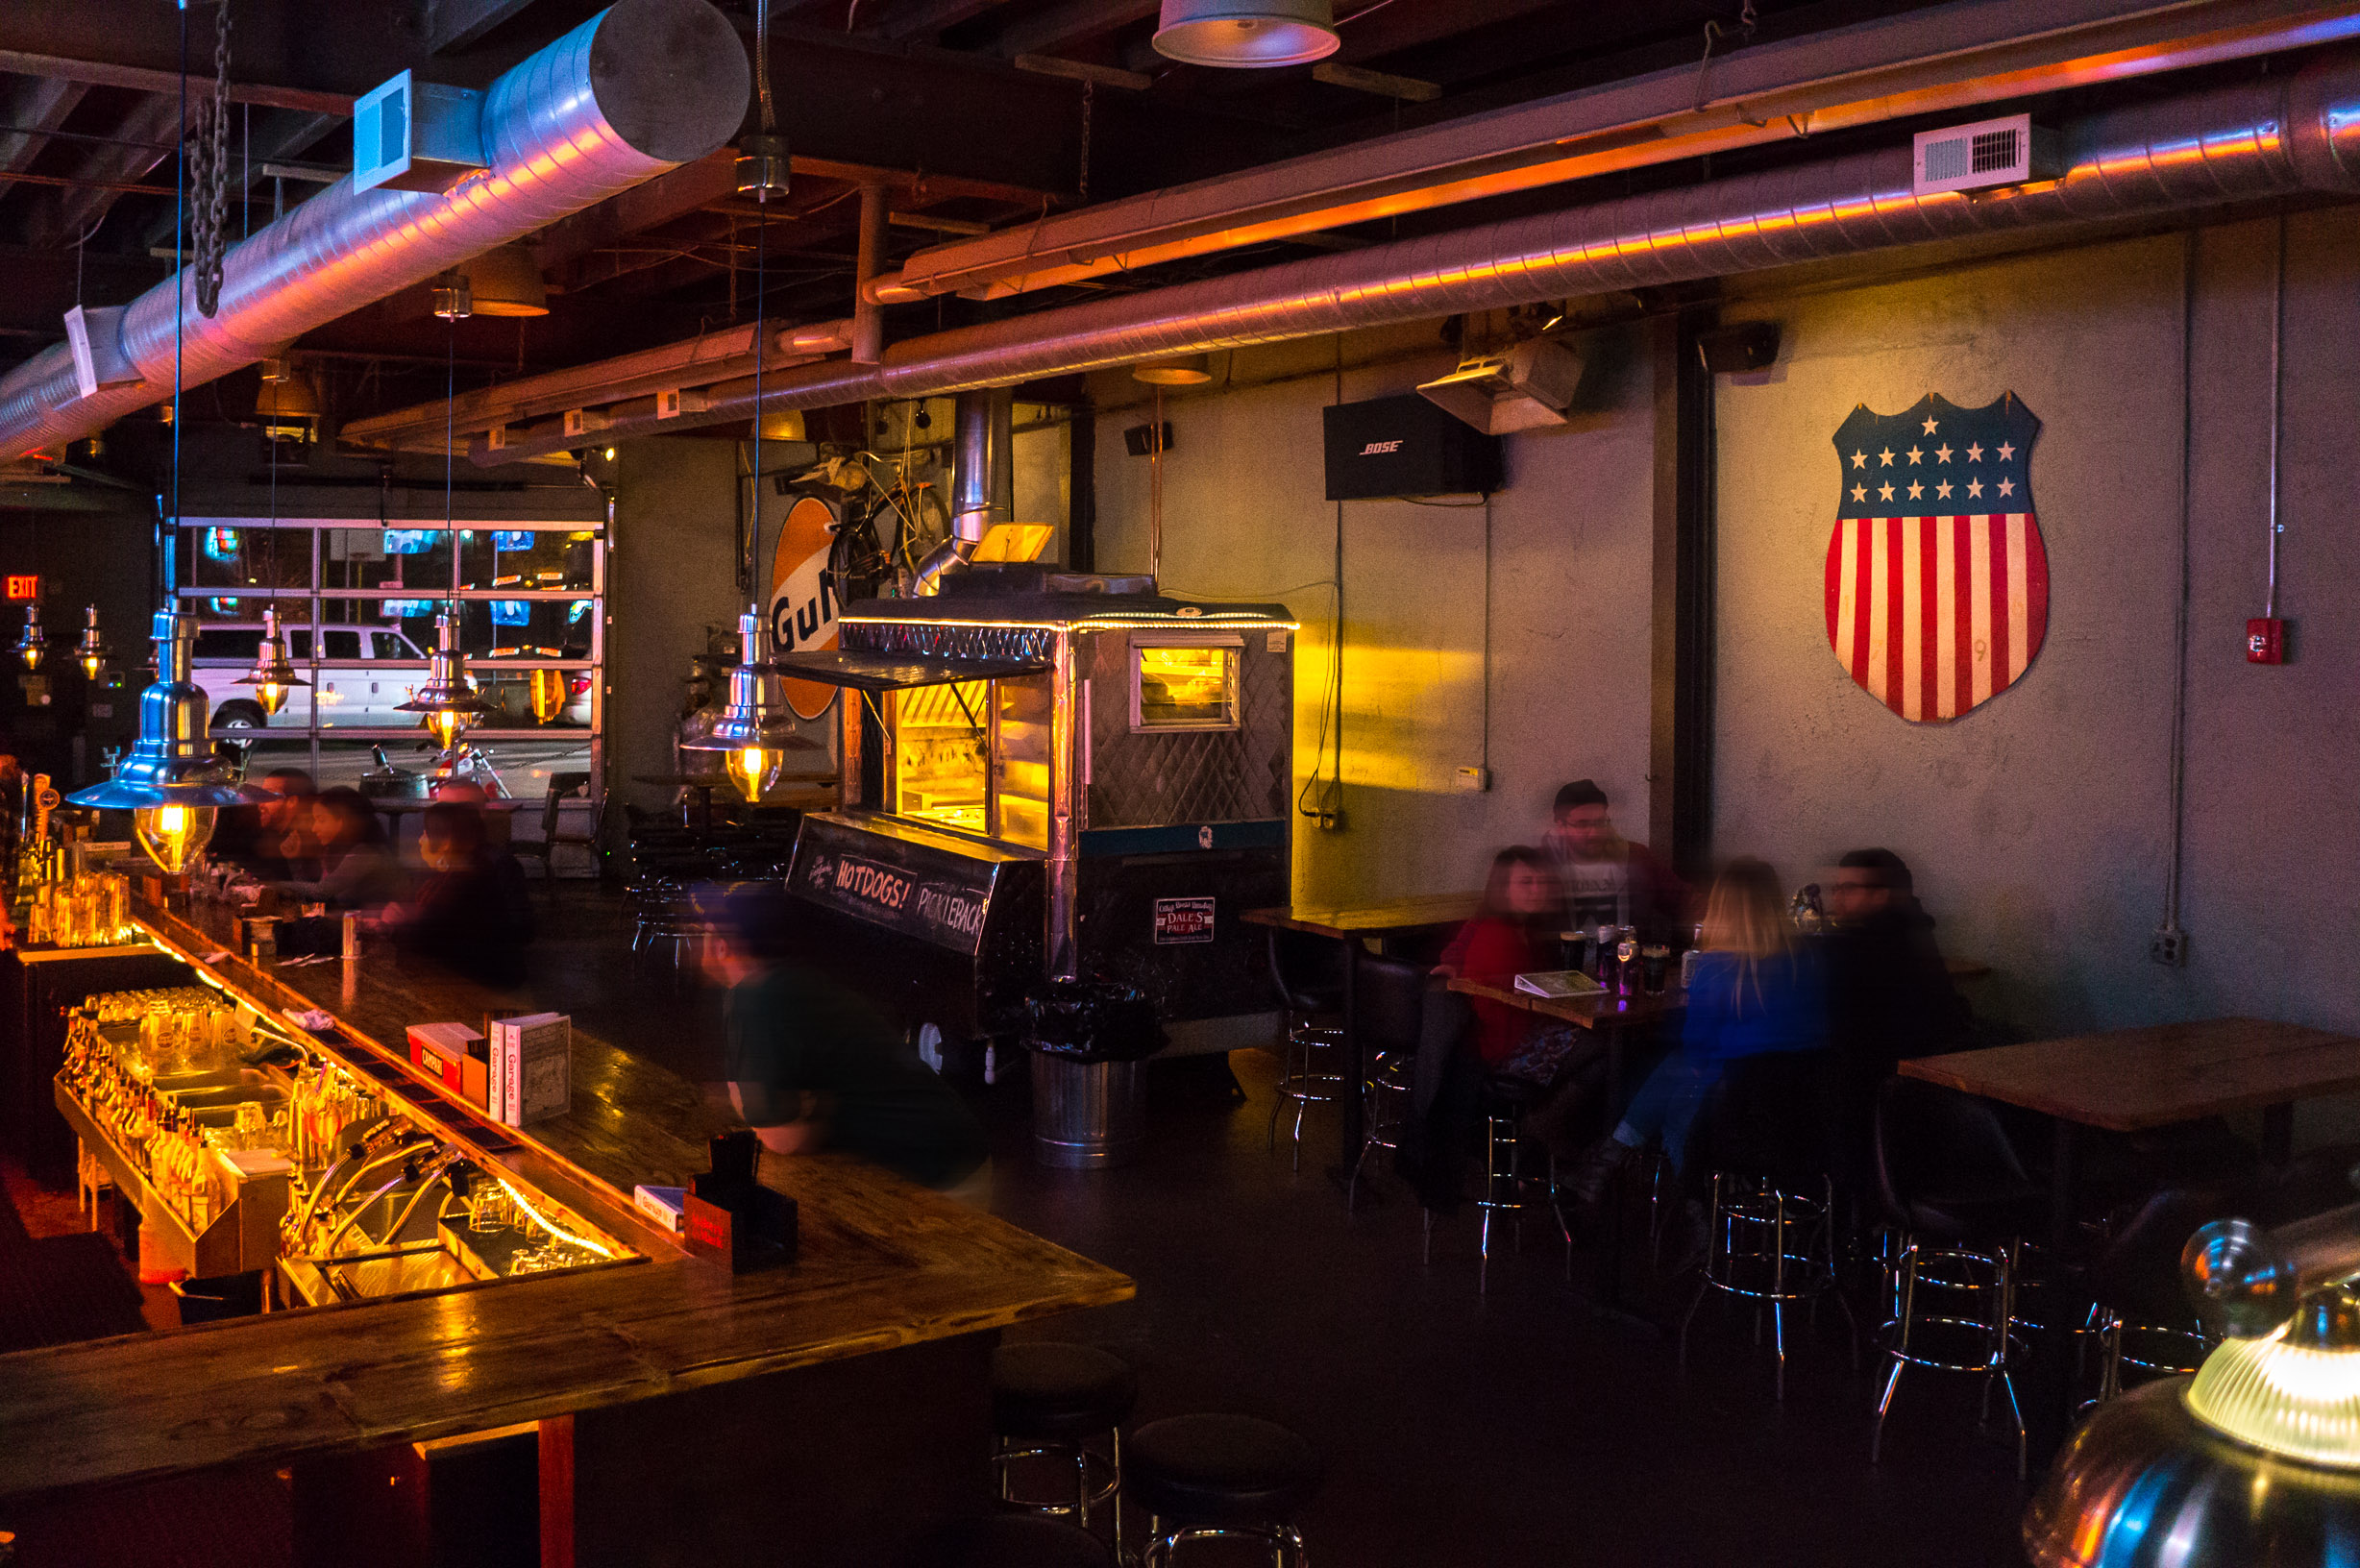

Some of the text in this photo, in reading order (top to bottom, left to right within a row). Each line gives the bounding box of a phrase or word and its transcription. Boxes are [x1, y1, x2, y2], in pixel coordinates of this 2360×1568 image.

[1359, 439, 1404, 456] BOSE
[8, 576, 38, 600] EXIT
[772, 569, 834, 652] Gul
[835, 859, 912, 910] HOTDOGS!
[1167, 923, 1204, 934] PALE ALE
[1168, 911, 1204, 924] DALE'S
[506, 1054, 517, 1100] Garage
